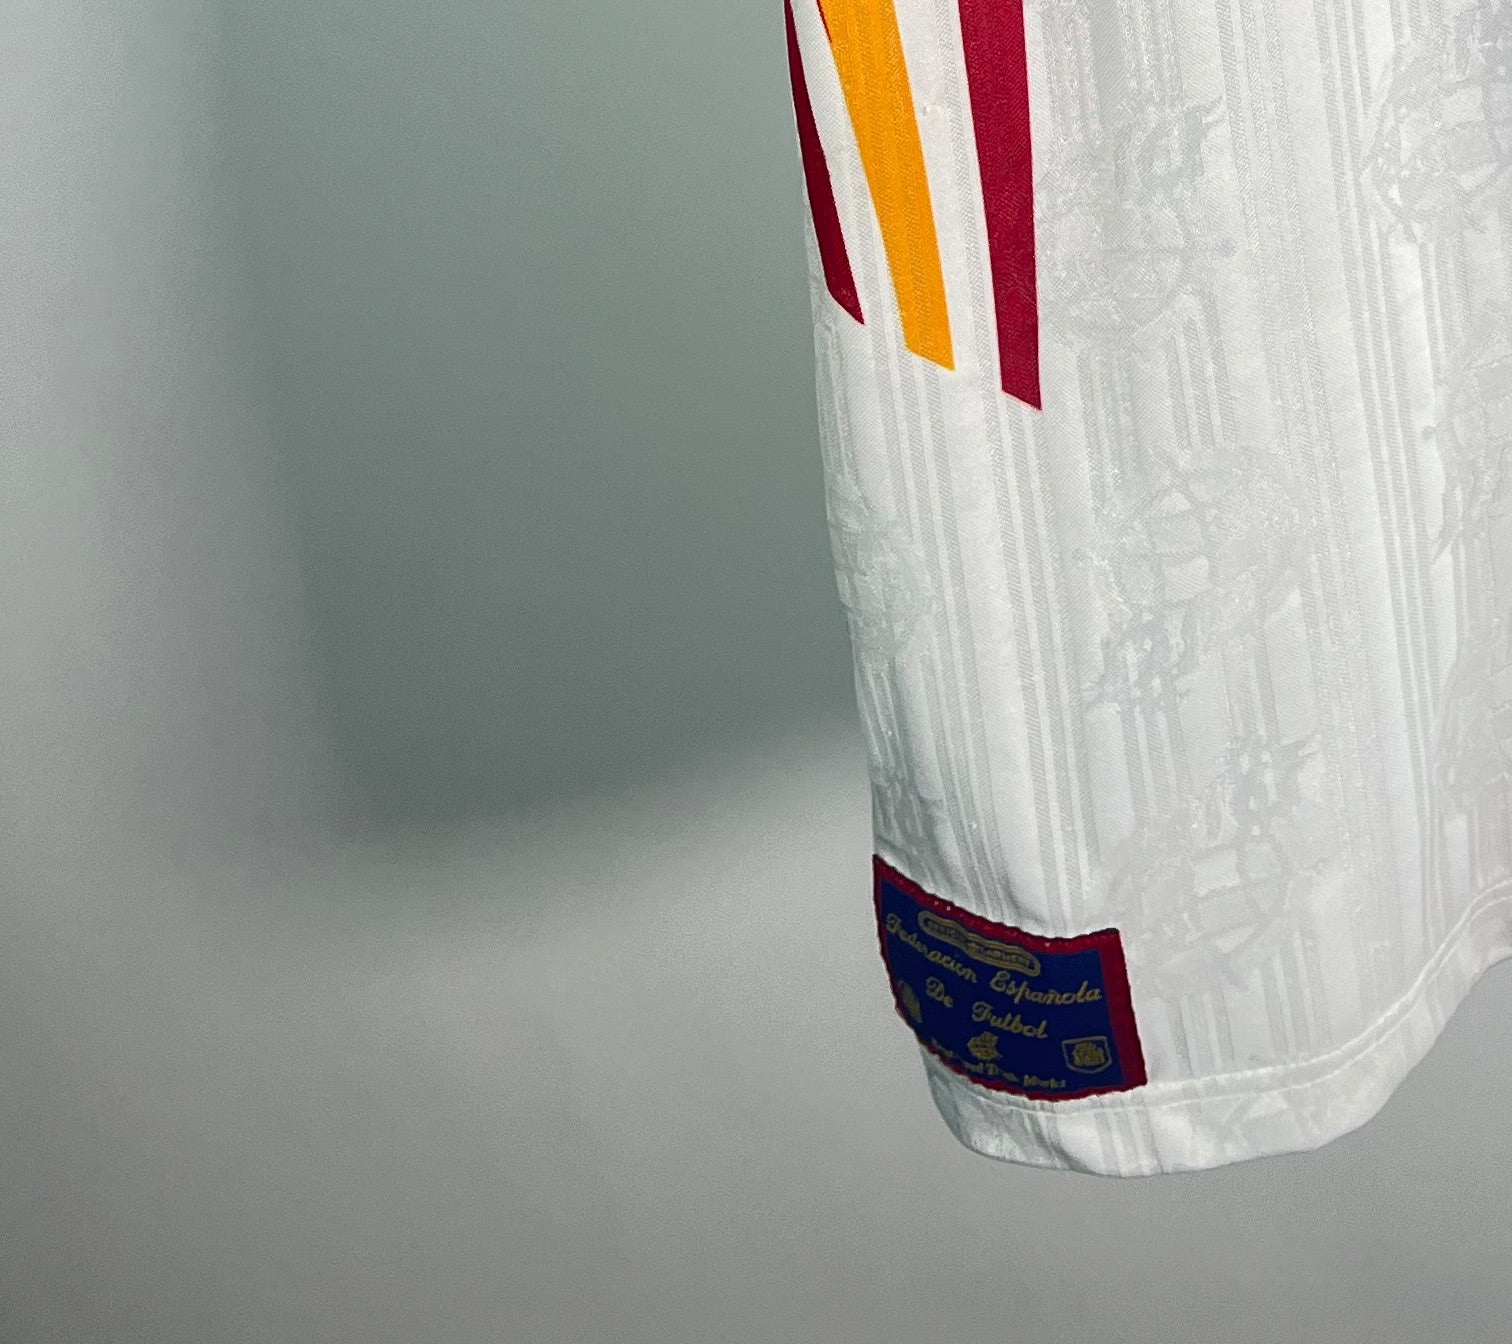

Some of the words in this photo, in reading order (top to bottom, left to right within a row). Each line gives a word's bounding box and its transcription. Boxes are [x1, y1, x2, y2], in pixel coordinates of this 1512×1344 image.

[926, 976, 954, 1008] De
[971, 1001, 1048, 1040] Futbol
[989, 970, 1103, 1006] Española
